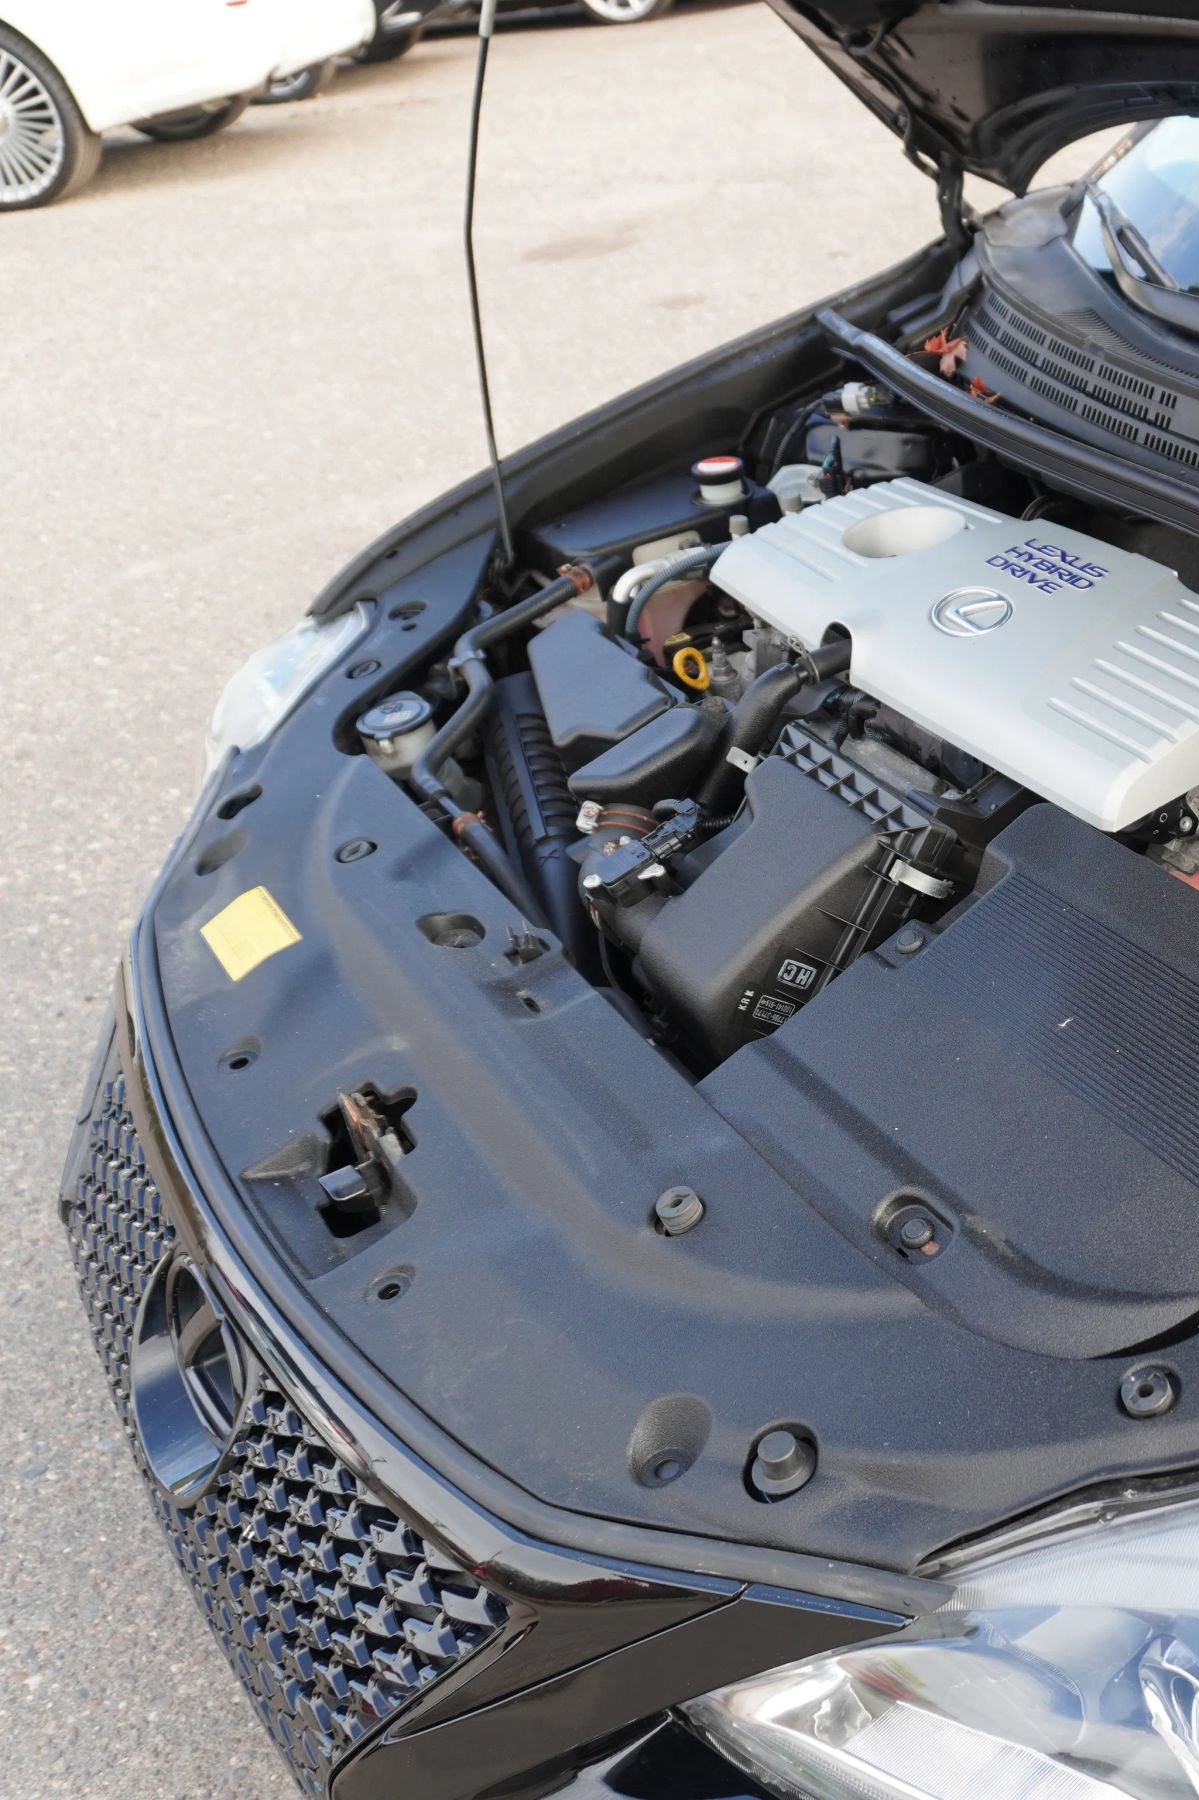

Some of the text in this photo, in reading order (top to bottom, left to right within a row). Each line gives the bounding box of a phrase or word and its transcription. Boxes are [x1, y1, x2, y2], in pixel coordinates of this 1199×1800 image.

[985, 555, 1064, 595] DRIVE
[1004, 546, 1095, 591] HYBRID
[1024, 538, 1110, 579] LEXUS
